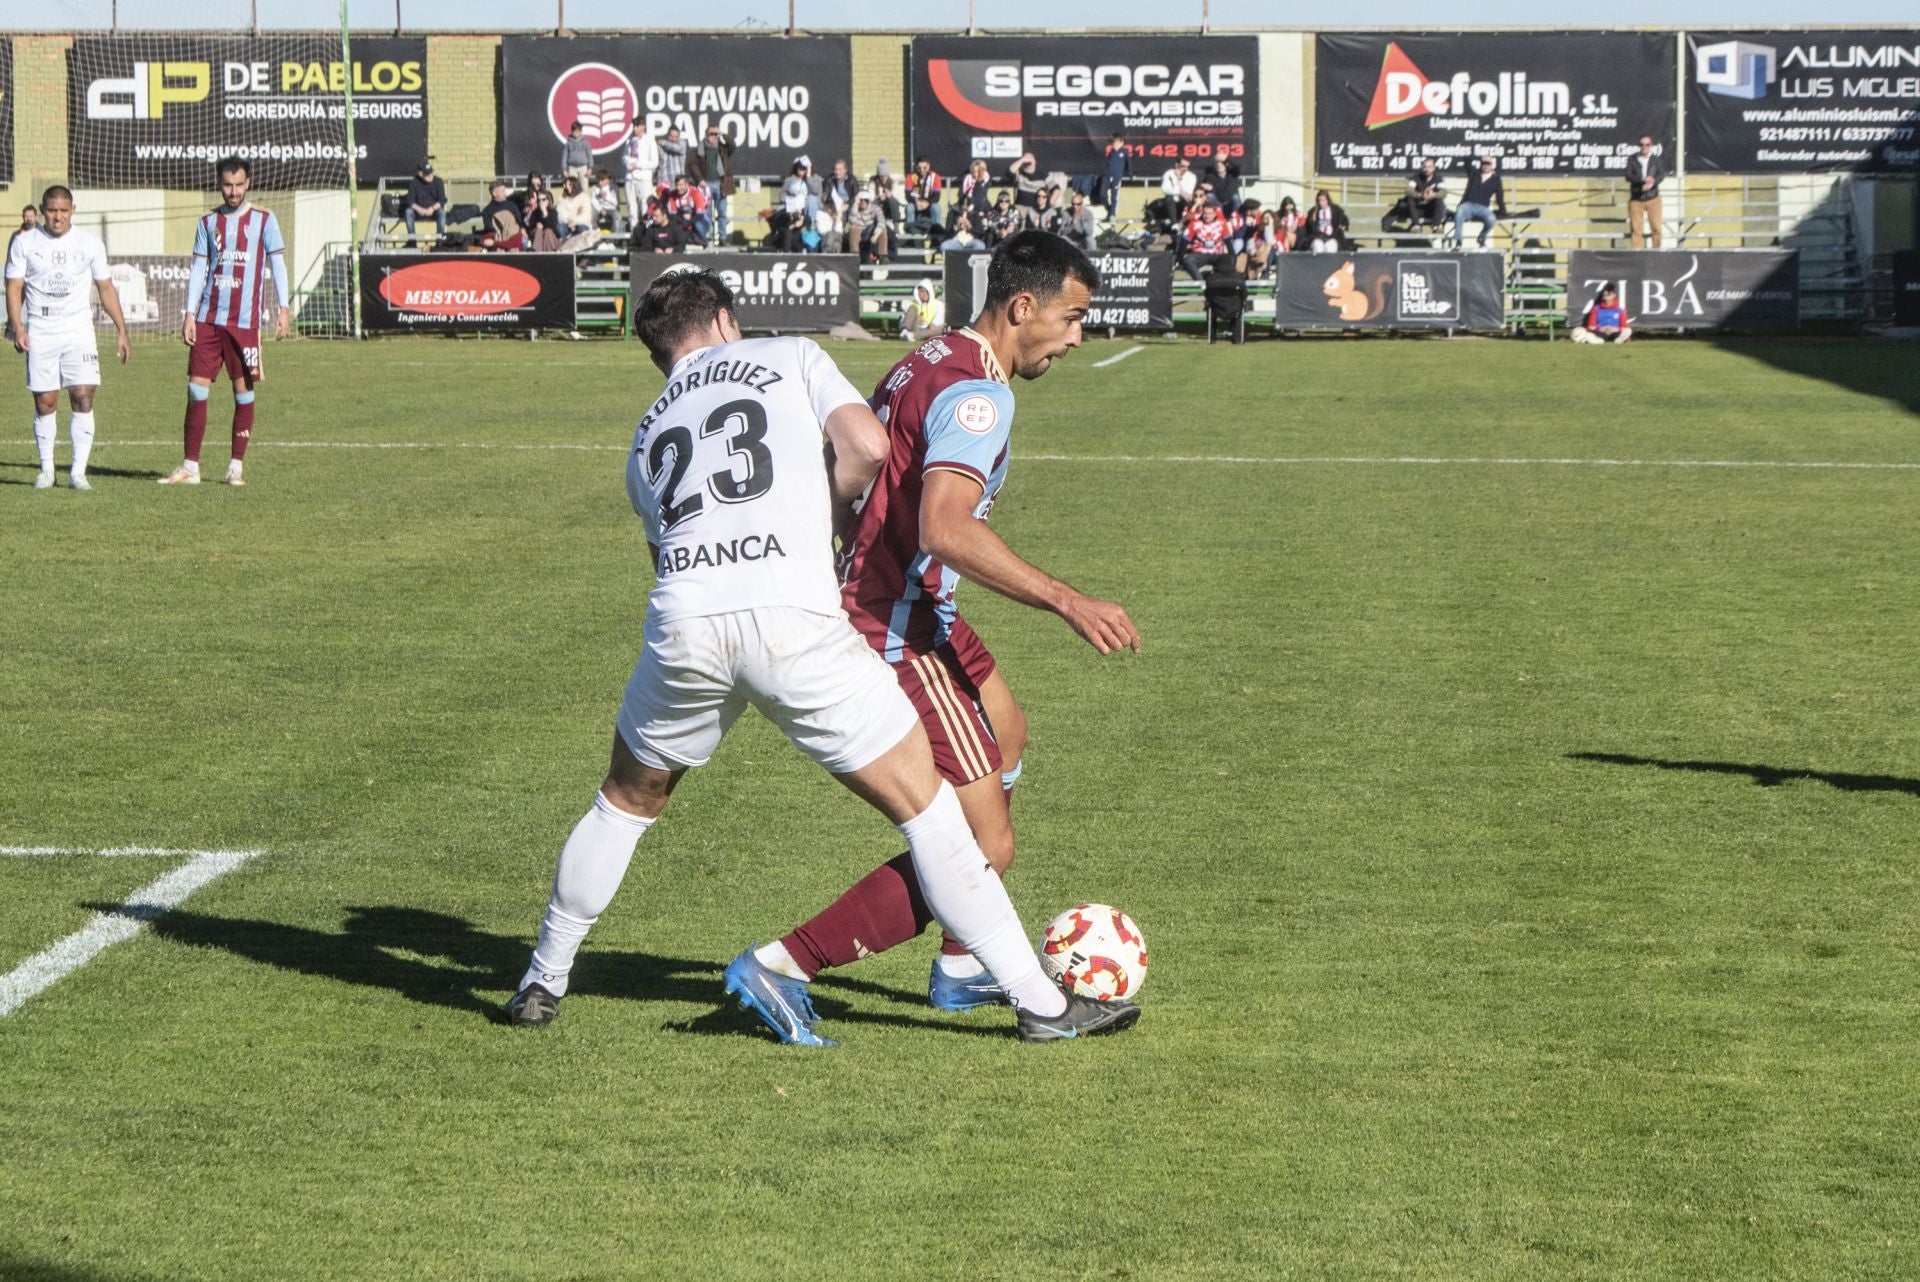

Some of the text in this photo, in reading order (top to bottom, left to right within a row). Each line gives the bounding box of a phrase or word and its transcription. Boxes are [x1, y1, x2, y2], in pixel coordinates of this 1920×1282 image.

[224, 61, 422, 92] DE PABLOS
[984, 64, 1245, 98] SEGOCAR
[1781, 77, 1834, 98] LUIS
[645, 85, 810, 112] OCTAVIANO
[224, 100, 423, 119] CORREDURÍA DE SEGUROS
[1036, 101, 1243, 116] RECAMBIOS
[645, 112, 810, 148] PALOMO
[1123, 116, 1243, 128] todo para automóvil
[1572, 117, 1618, 128] Servicios
[1535, 131, 1542, 143] y
[1150, 143, 1179, 157] 42
[1184, 143, 1212, 157] 90
[1561, 143, 1577, 156] del
[1757, 149, 1816, 161] Elaborador
[1110, 275, 1149, 289] pladur
[404, 290, 512, 305] MESTOLAYA
[398, 312, 520, 324] Ingeniería y Construcción
[1103, 308, 1125, 324] 427
[1126, 308, 1150, 325] 998
[242, 347, 258, 367] 22
[639, 359, 784, 434] RODRÍGUEZ
[646, 398, 774, 532] 23
[660, 533, 787, 576] ABANCA
